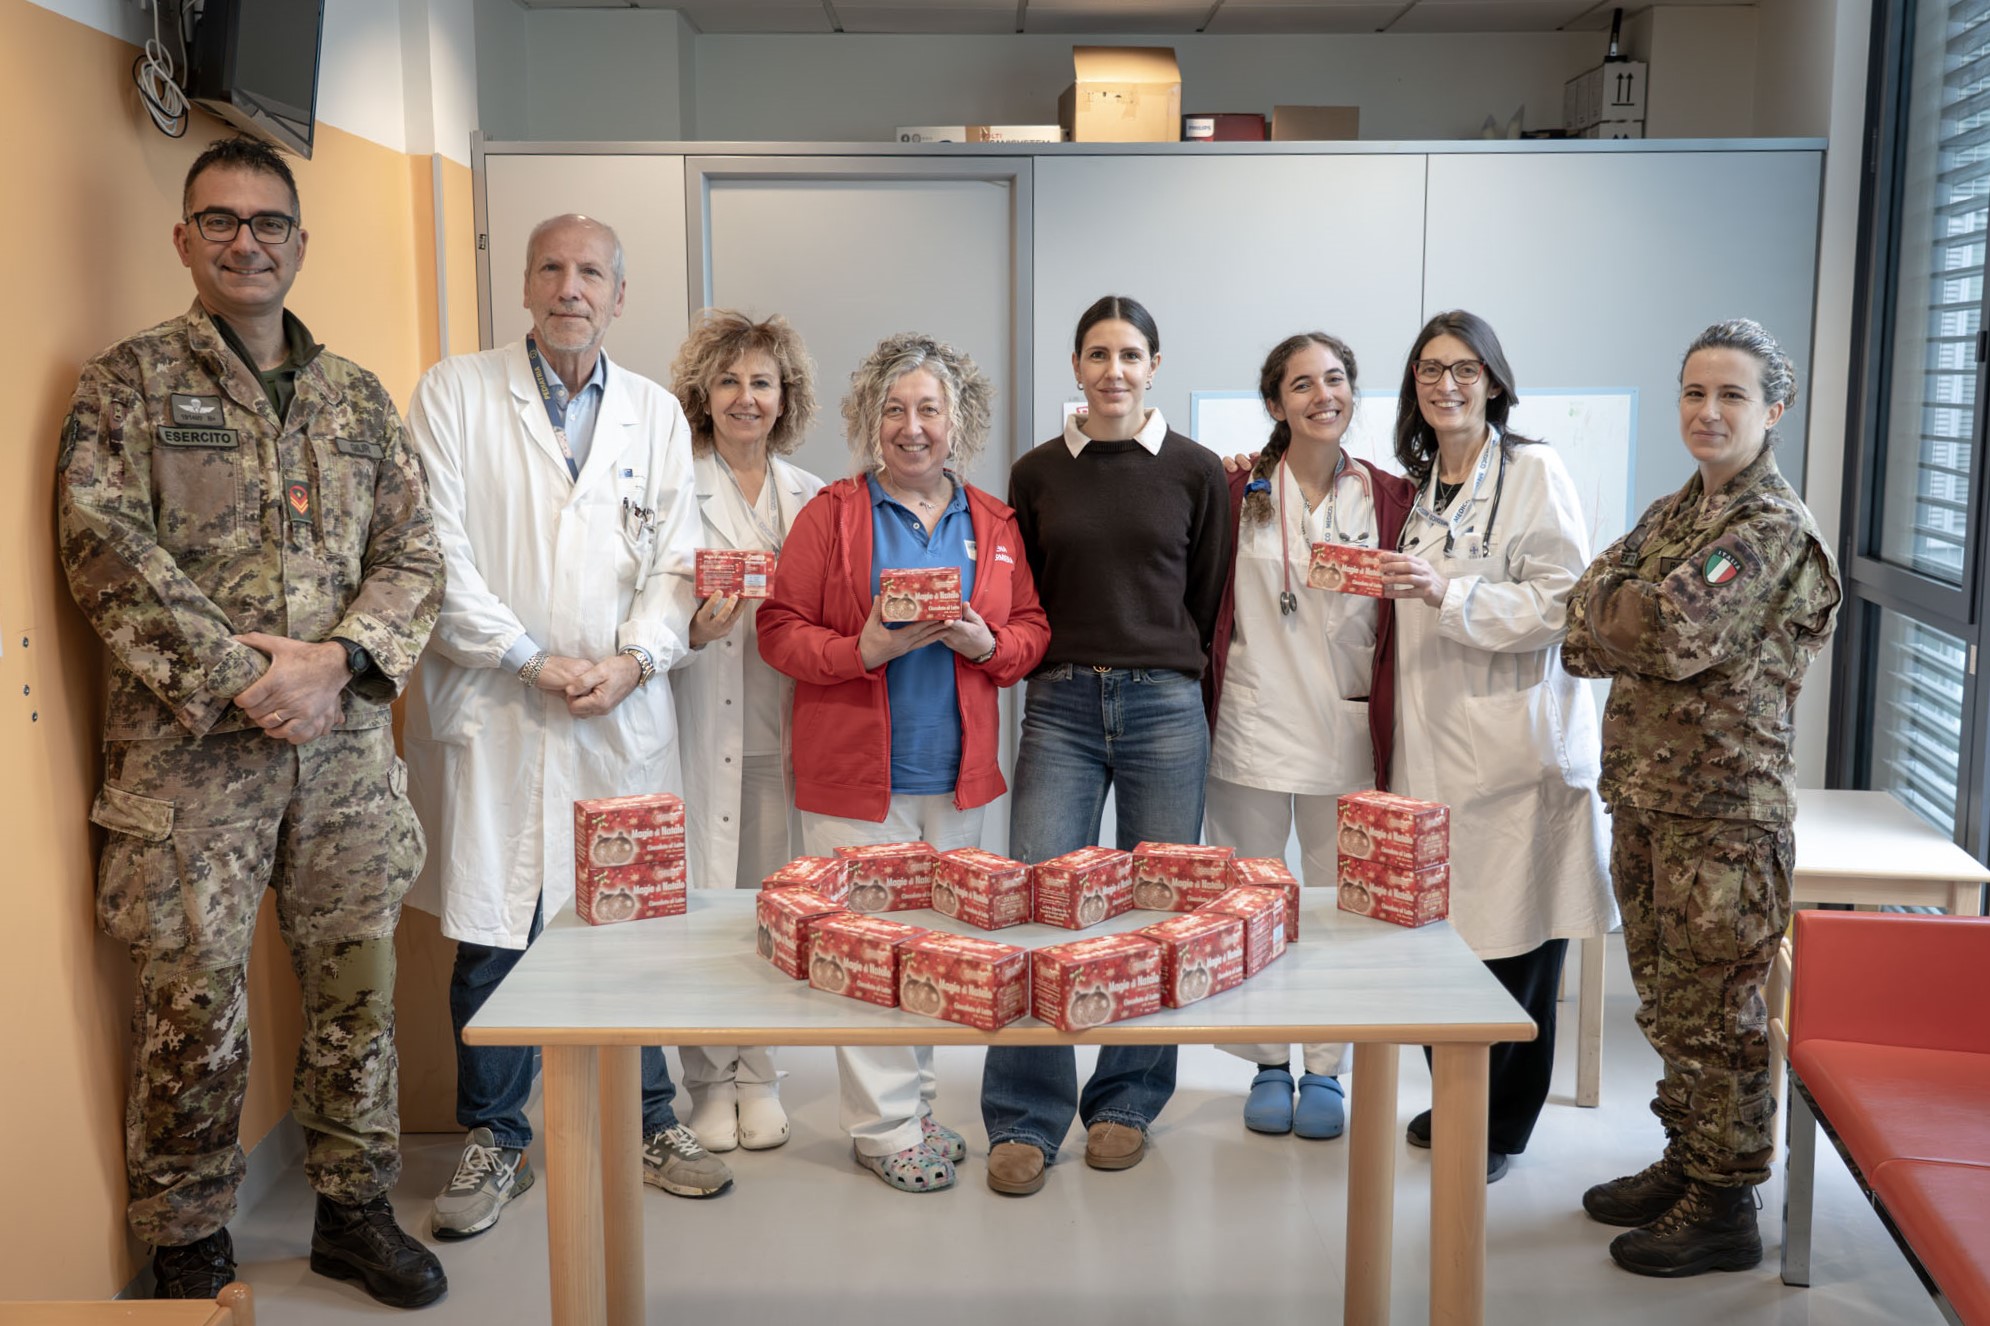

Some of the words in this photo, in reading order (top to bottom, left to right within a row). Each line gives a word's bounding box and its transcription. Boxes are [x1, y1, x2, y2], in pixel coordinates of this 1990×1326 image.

[534, 366, 551, 400] PEDIATRIA
[164, 429, 232, 443] ESERCITO
[1325, 506, 1333, 529] MEDICO
[1718, 549, 1741, 571] ITALIA
[631, 829, 654, 841] Magie
[661, 825, 685, 836] Natale
[633, 884, 655, 896] Magie
[662, 881, 686, 892] Natale
[1172, 878, 1194, 890] Magie
[1202, 879, 1226, 890] Natale
